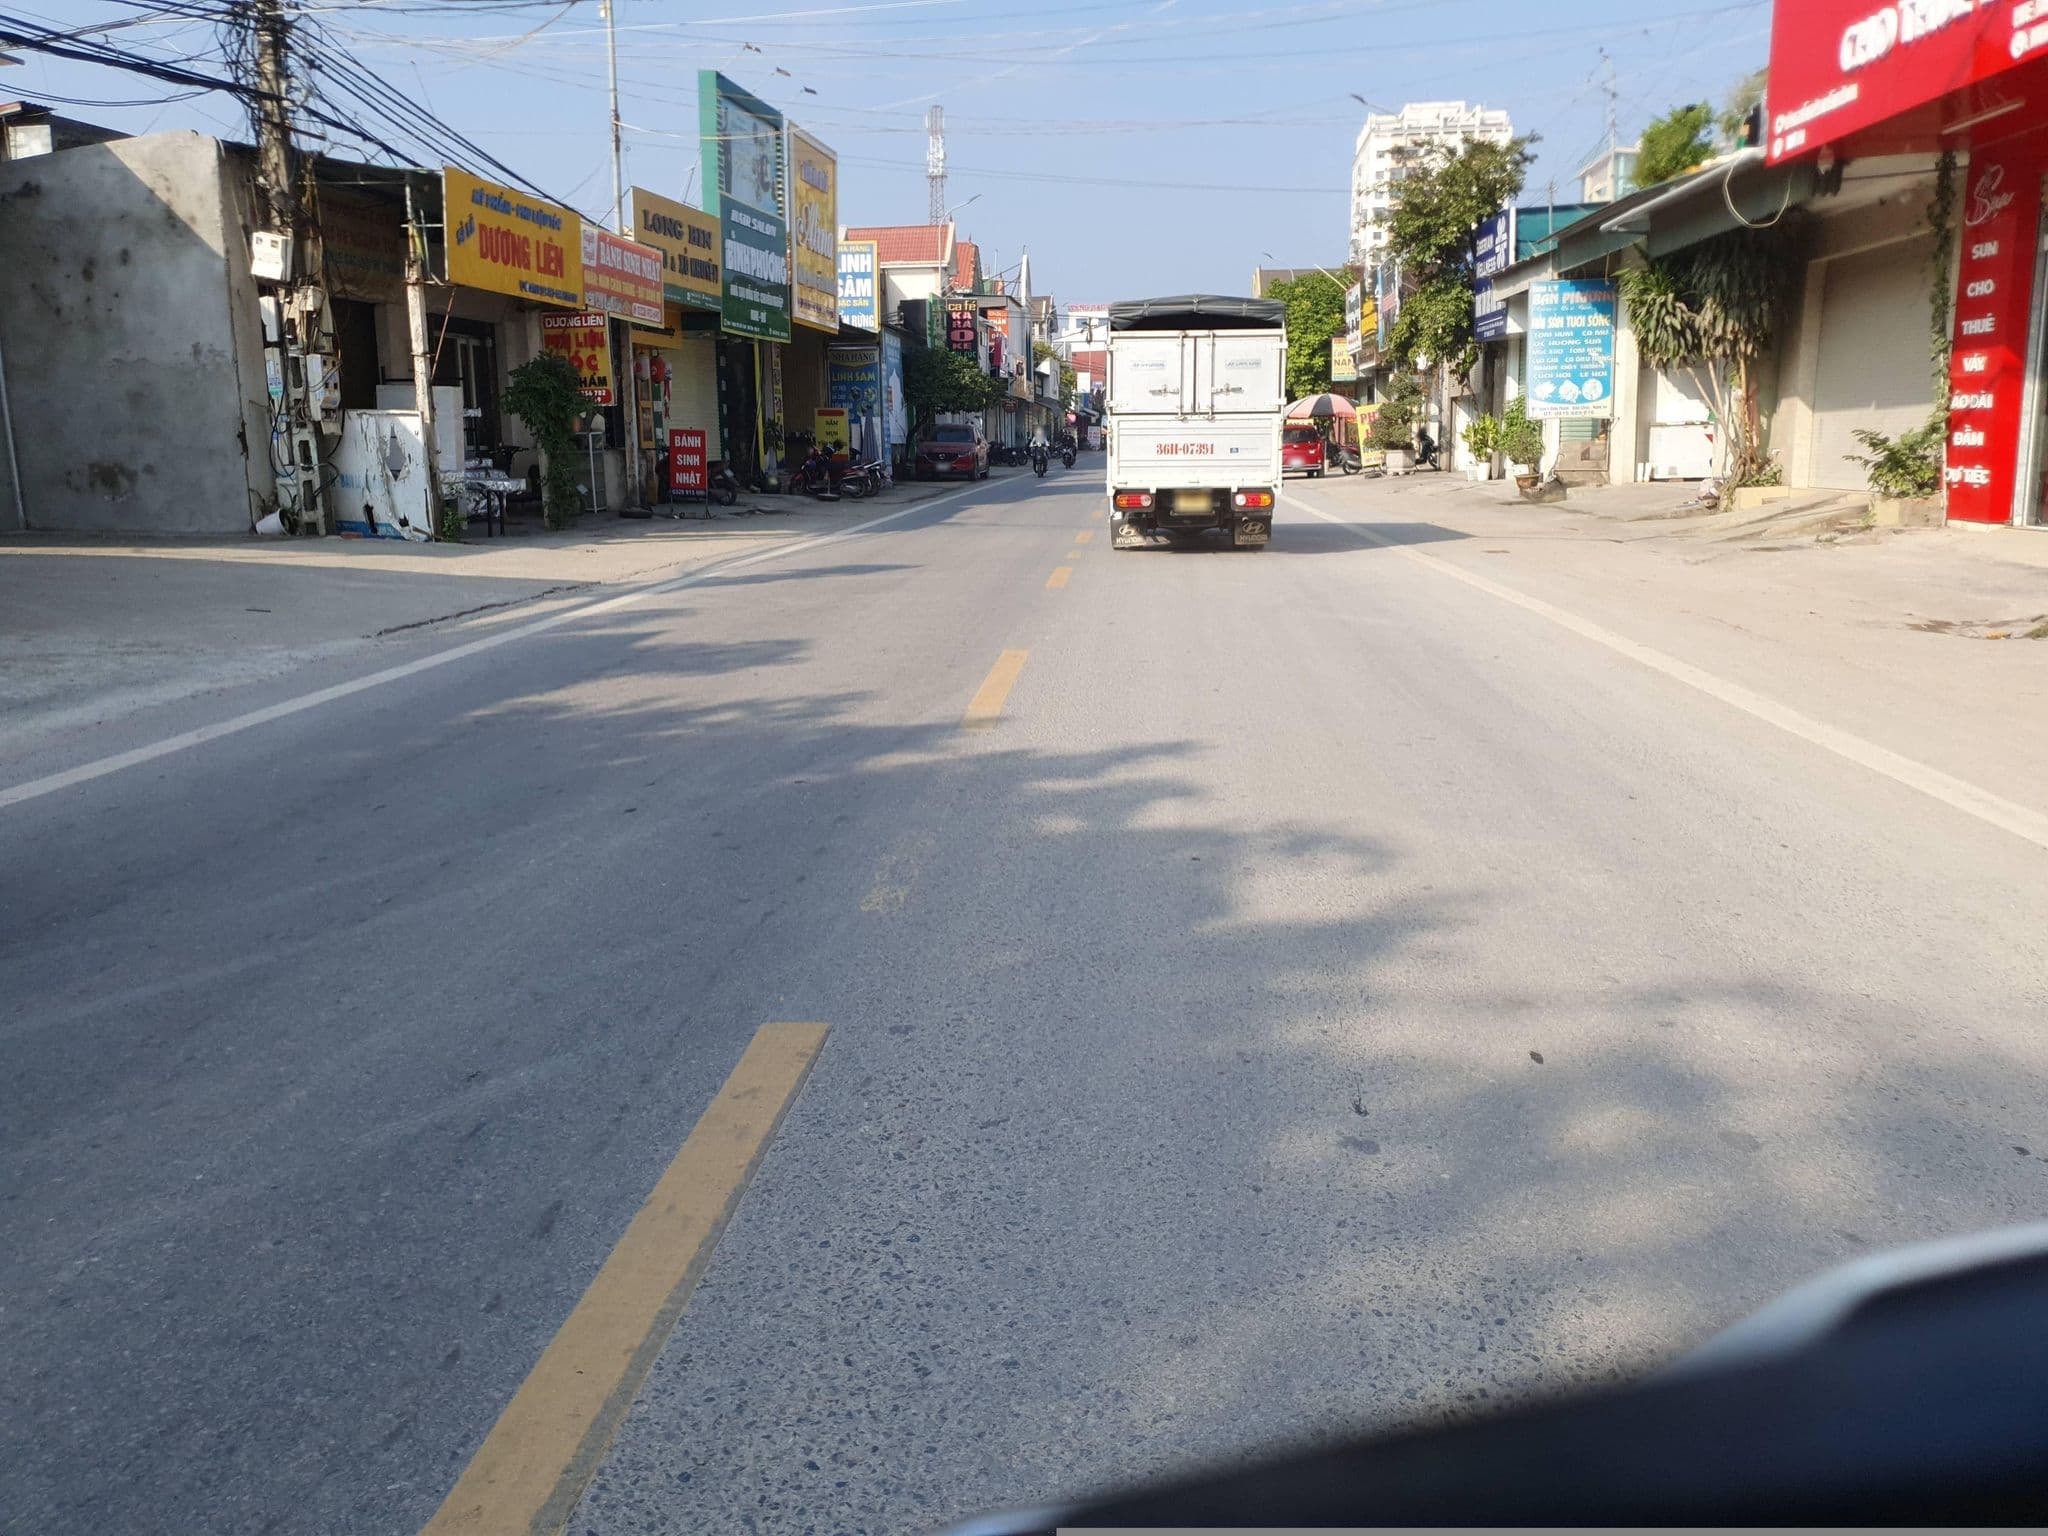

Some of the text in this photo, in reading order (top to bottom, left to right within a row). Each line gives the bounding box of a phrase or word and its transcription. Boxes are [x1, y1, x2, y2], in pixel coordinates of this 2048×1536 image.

[642, 208, 684, 241] LONG
[1971, 240, 1999, 260] SUN
[1966, 278, 1996, 298] CHO
[582, 313, 605, 327] LIÊN
[1962, 352, 1988, 373] VÁY
[578, 371, 608, 388] HẨM
[674, 433, 702, 449] BÁNH
[676, 453, 701, 467] SINH
[675, 470, 702, 488] NHẬT
